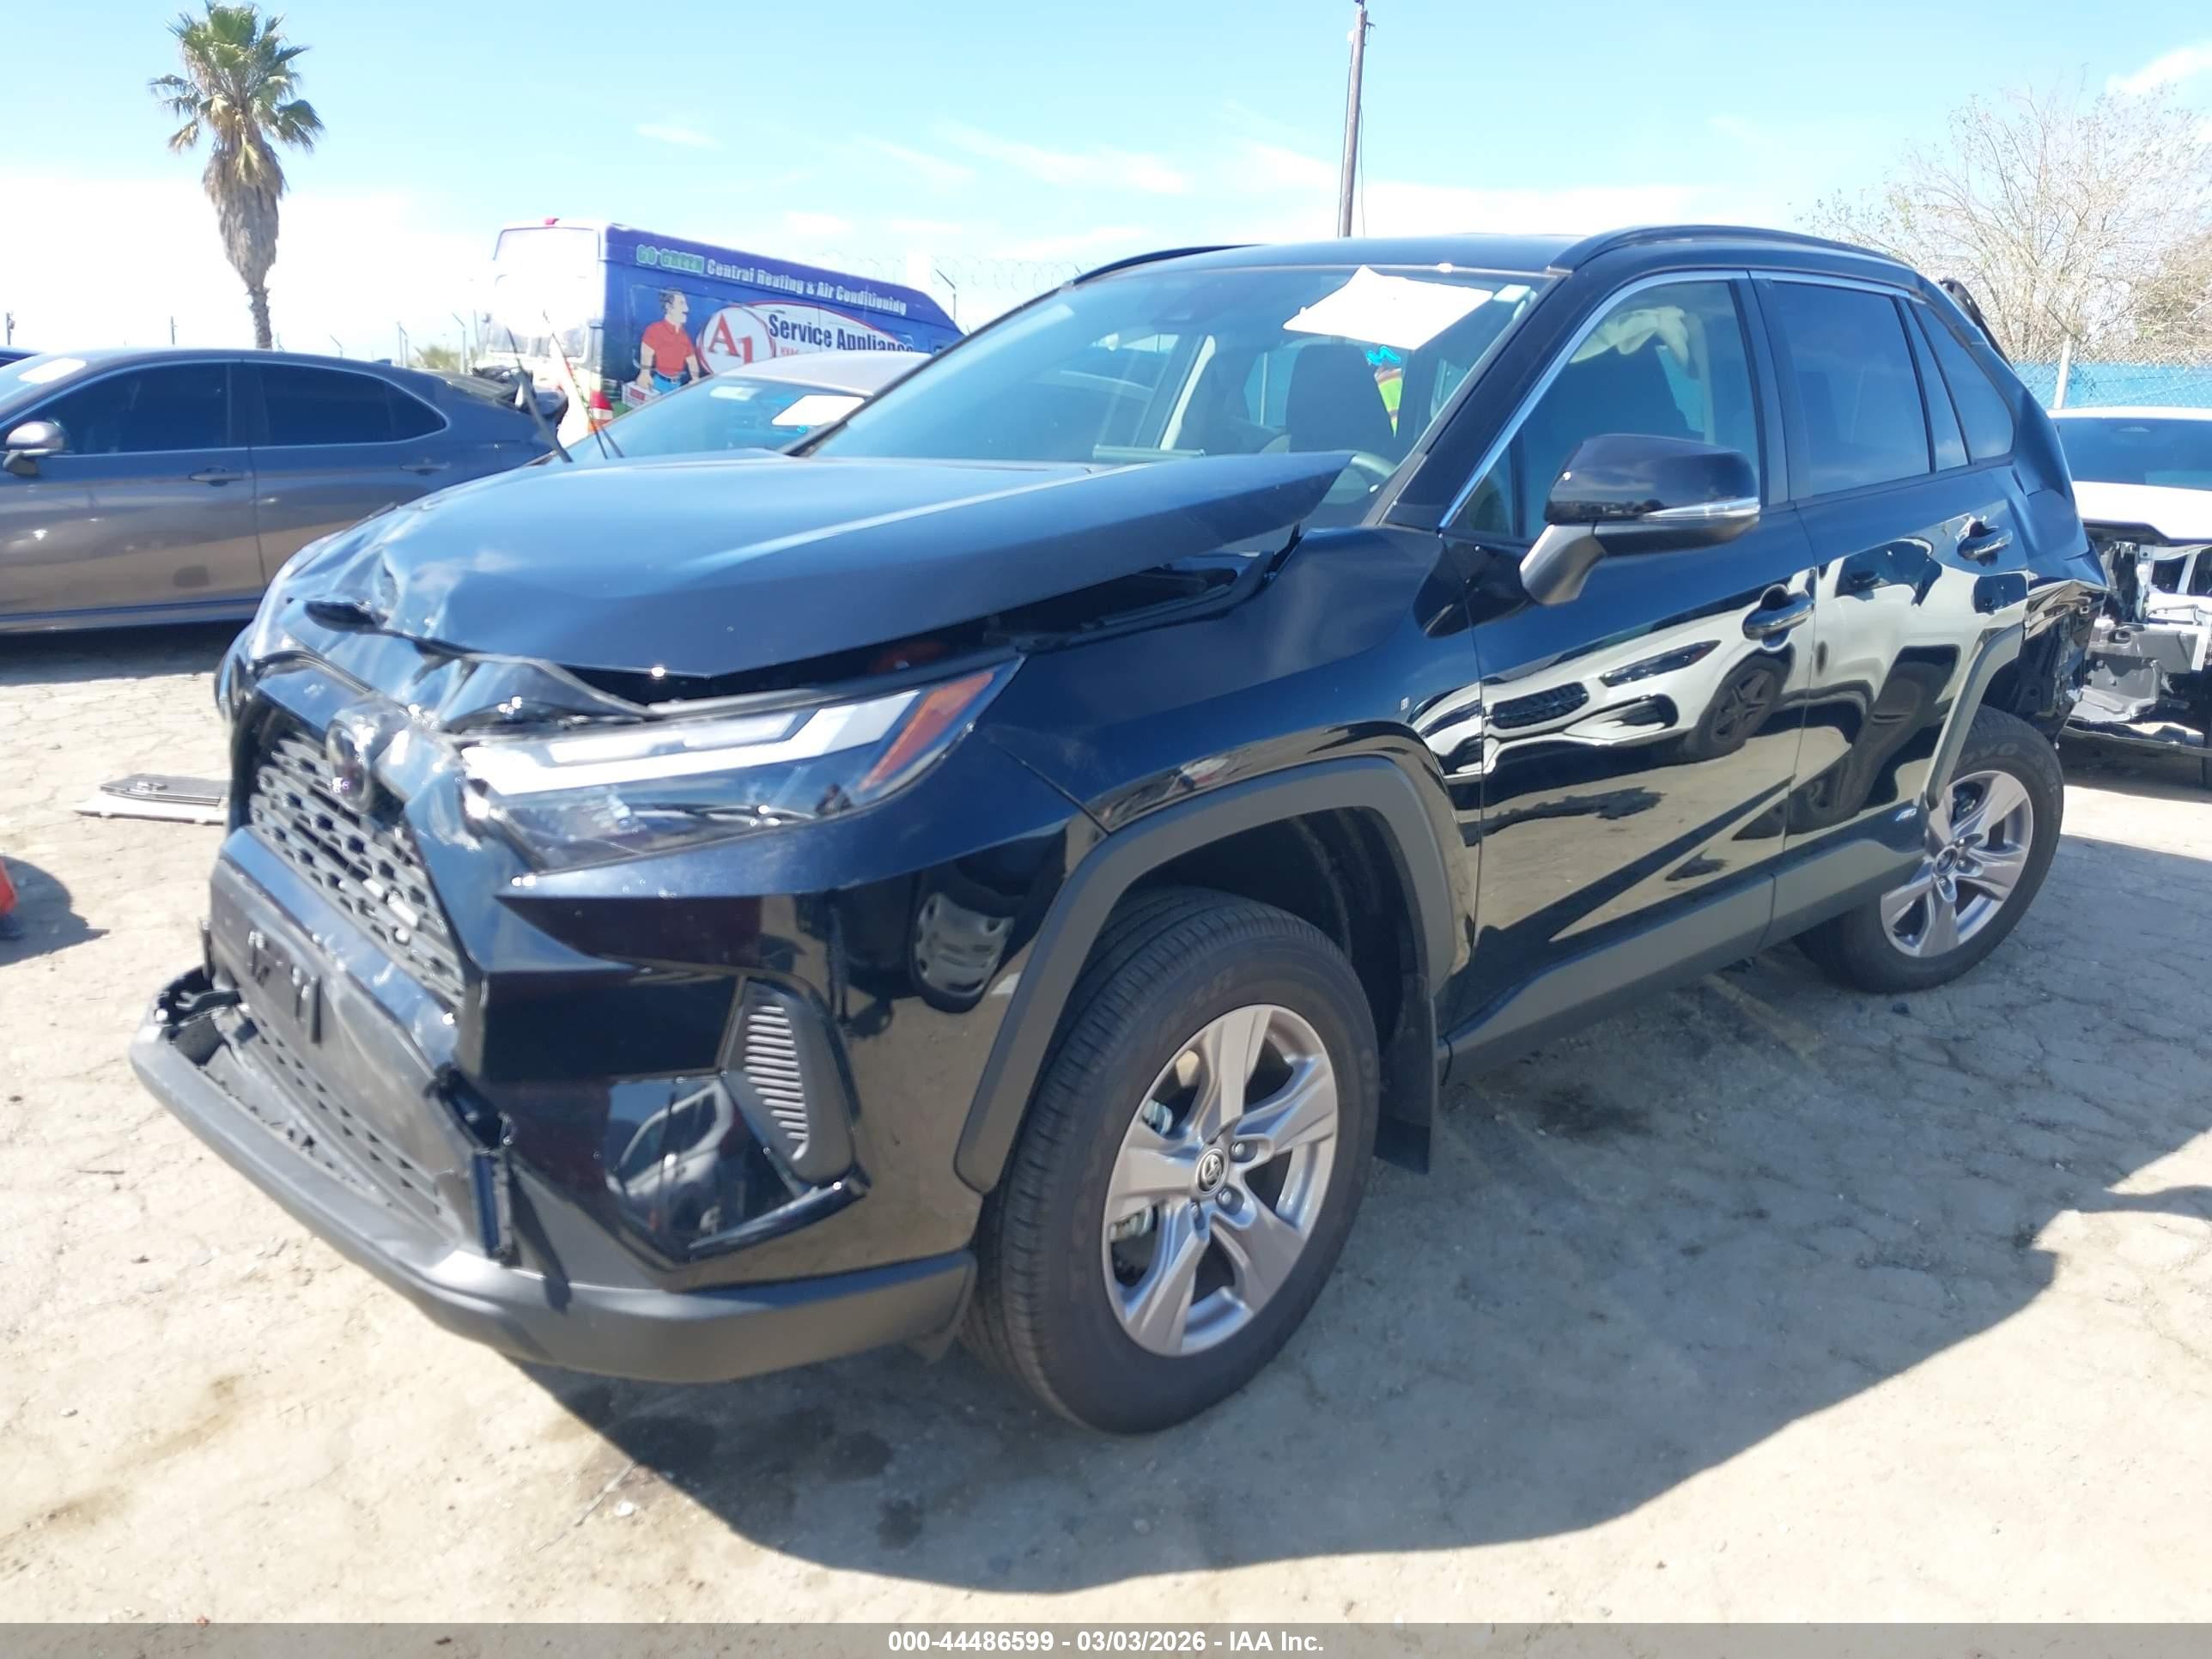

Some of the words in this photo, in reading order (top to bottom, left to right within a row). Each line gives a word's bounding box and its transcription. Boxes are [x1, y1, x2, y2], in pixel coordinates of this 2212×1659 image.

[707, 258, 755, 283] Central
[757, 269, 804, 295] Heating
[806, 282, 815, 295] &
[817, 282, 835, 299] Air
[836, 285, 907, 316] Conditioning
[769, 313, 832, 348] Service
